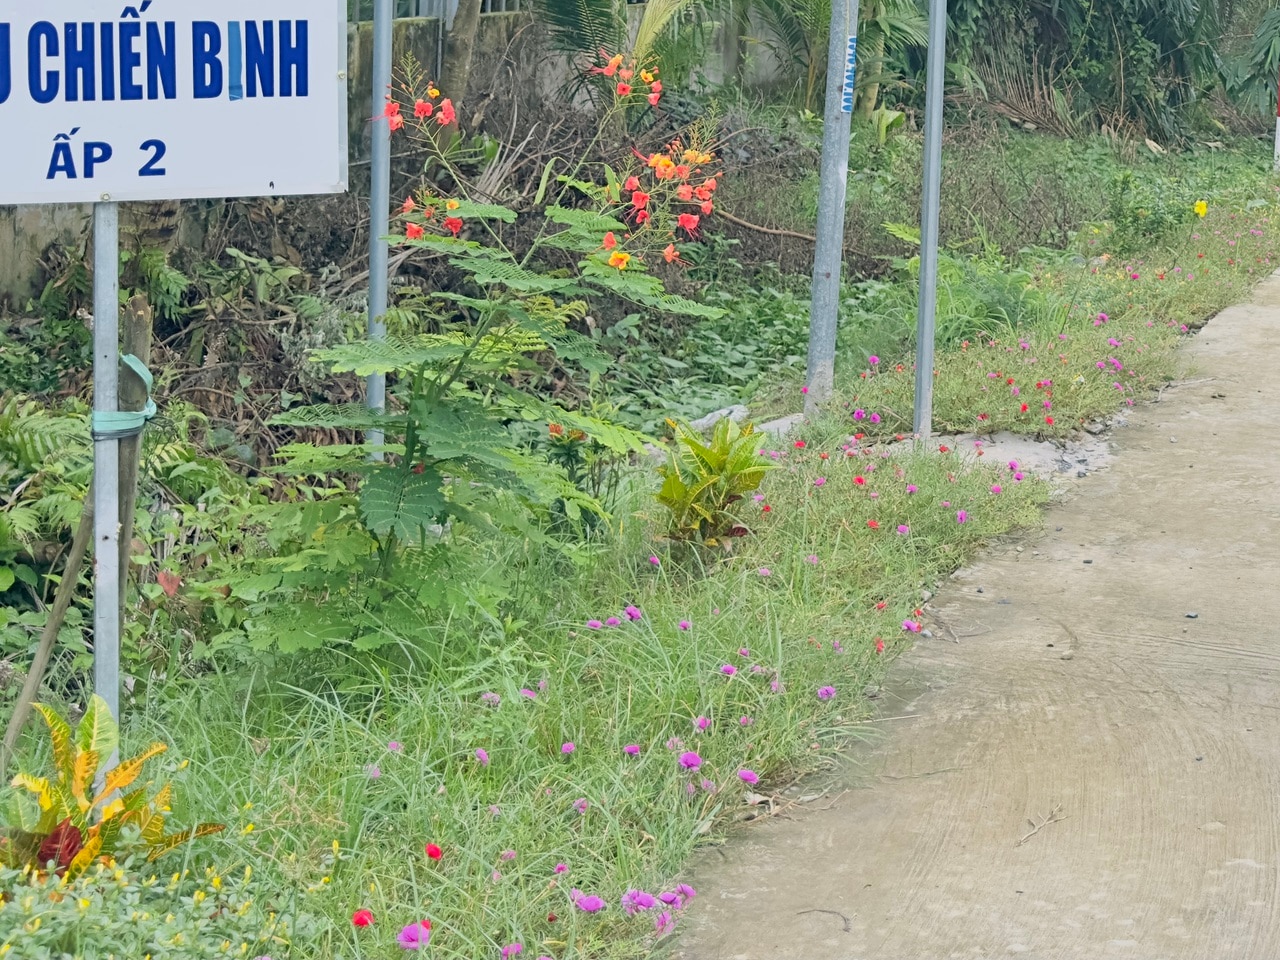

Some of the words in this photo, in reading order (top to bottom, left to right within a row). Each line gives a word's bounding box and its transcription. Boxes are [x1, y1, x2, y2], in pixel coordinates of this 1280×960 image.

[27, 0, 177, 105] CHIẾN
[47, 127, 113, 180] ẤP
[138, 138, 167, 177] 2
